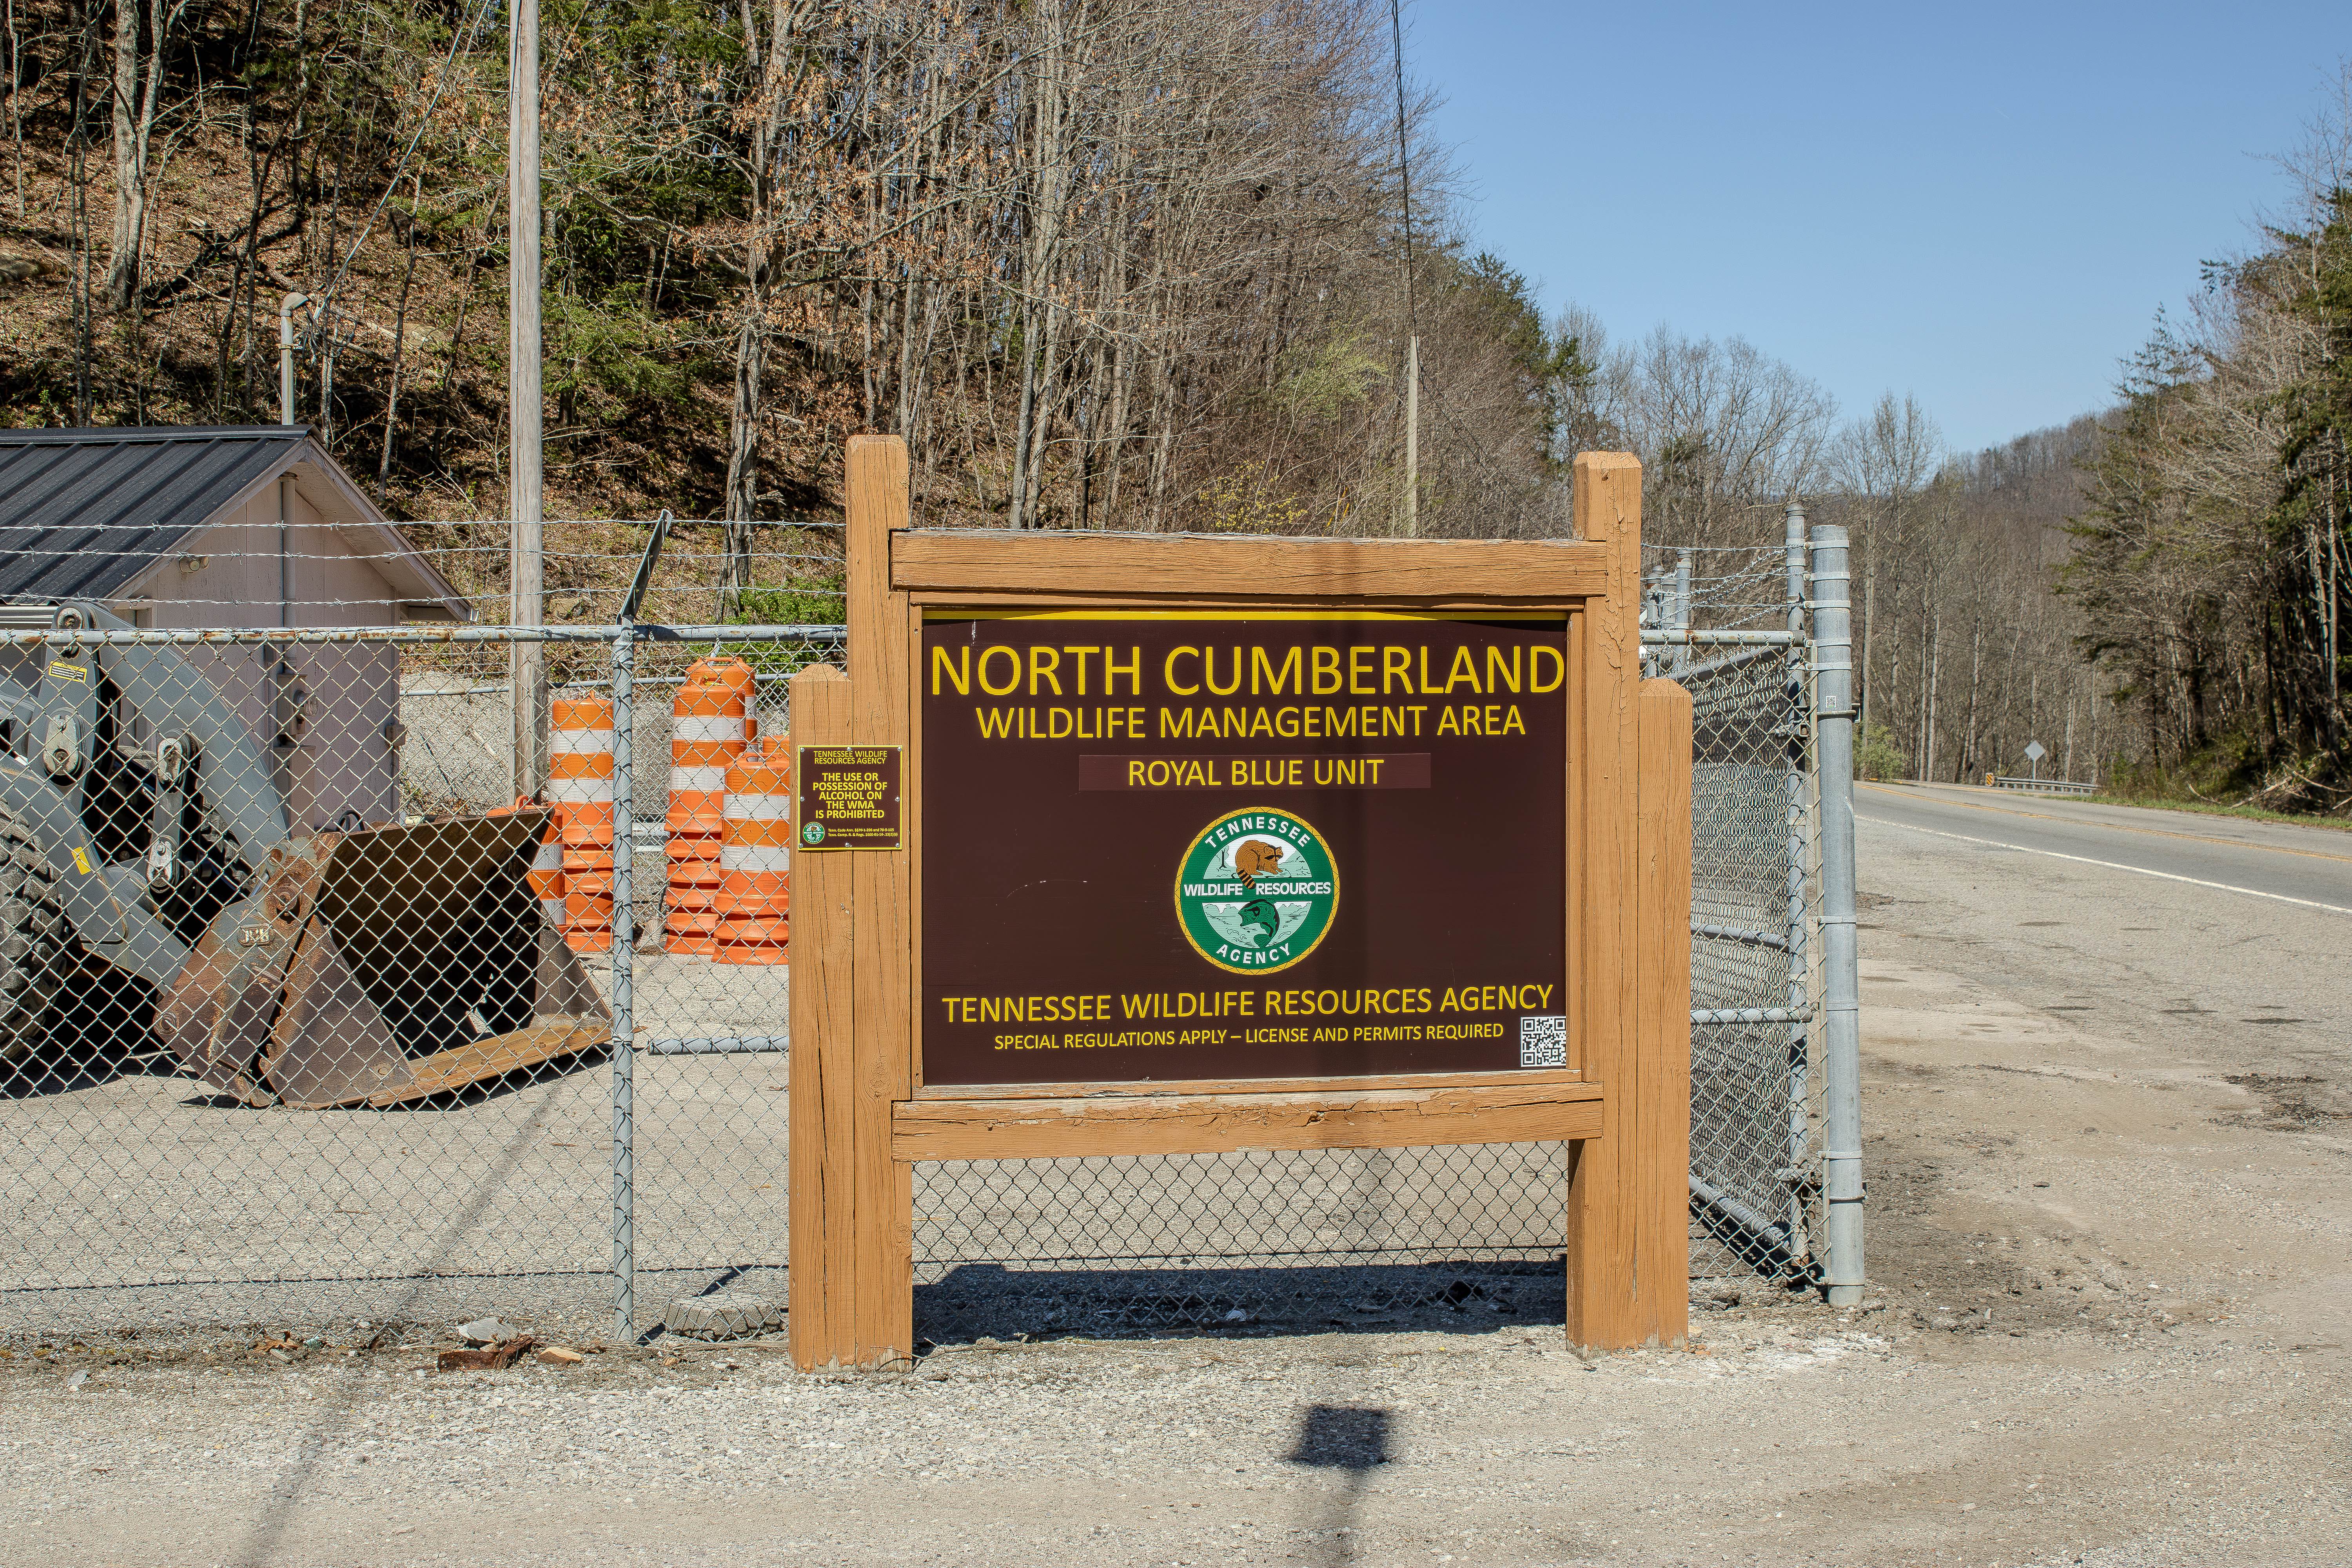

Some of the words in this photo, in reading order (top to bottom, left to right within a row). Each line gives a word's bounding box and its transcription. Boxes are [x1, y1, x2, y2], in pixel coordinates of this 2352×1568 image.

[932, 645, 1140, 695] NORTH
[1164, 645, 1564, 695] CUMBERLAND
[975, 707, 1146, 739] WILDLIFE
[1160, 705, 1428, 738] MANAGEMENT
[1437, 704, 1526, 736] AREA
[822, 773, 841, 781] THE
[843, 772, 862, 781] USE
[864, 772, 878, 781] OR
[1129, 760, 1222, 786] ROYAL
[1231, 759, 1303, 786] BLUE
[1314, 759, 1385, 785] UNIT
[813, 782, 871, 791] POSSESSION
[874, 782, 887, 791] OF
[818, 791, 865, 800] ALCOHOL
[866, 791, 882, 800] ON
[815, 810, 824, 819] IS
[826, 809, 885, 818] PROHIBITED
[825, 800, 844, 809] THE
[847, 800, 875, 809] WMA
[1205, 817, 1310, 848] TENNESSEE
[1184, 883, 1243, 897] WILDLIFE
[1256, 882, 1331, 895] RESOURCES
[1216, 942, 1291, 964] AGENCY
[941, 995, 1111, 1023] TENNESSEE
[1120, 991, 1255, 1019] WILDLIFE
[1265, 988, 1432, 1016] RESOURCES
[1439, 984, 1553, 1013] AGENCY
[994, 1034, 1060, 1051] SPECIAL
[1064, 1031, 1175, 1049] REGULATIONS
[1179, 1030, 1227, 1045] APPLY
[1246, 1027, 1309, 1043] LICENSE
[1312, 1027, 1348, 1042] AND
[1354, 1025, 1422, 1042] PERMITS
[1426, 1023, 1504, 1041] REQUIRED
